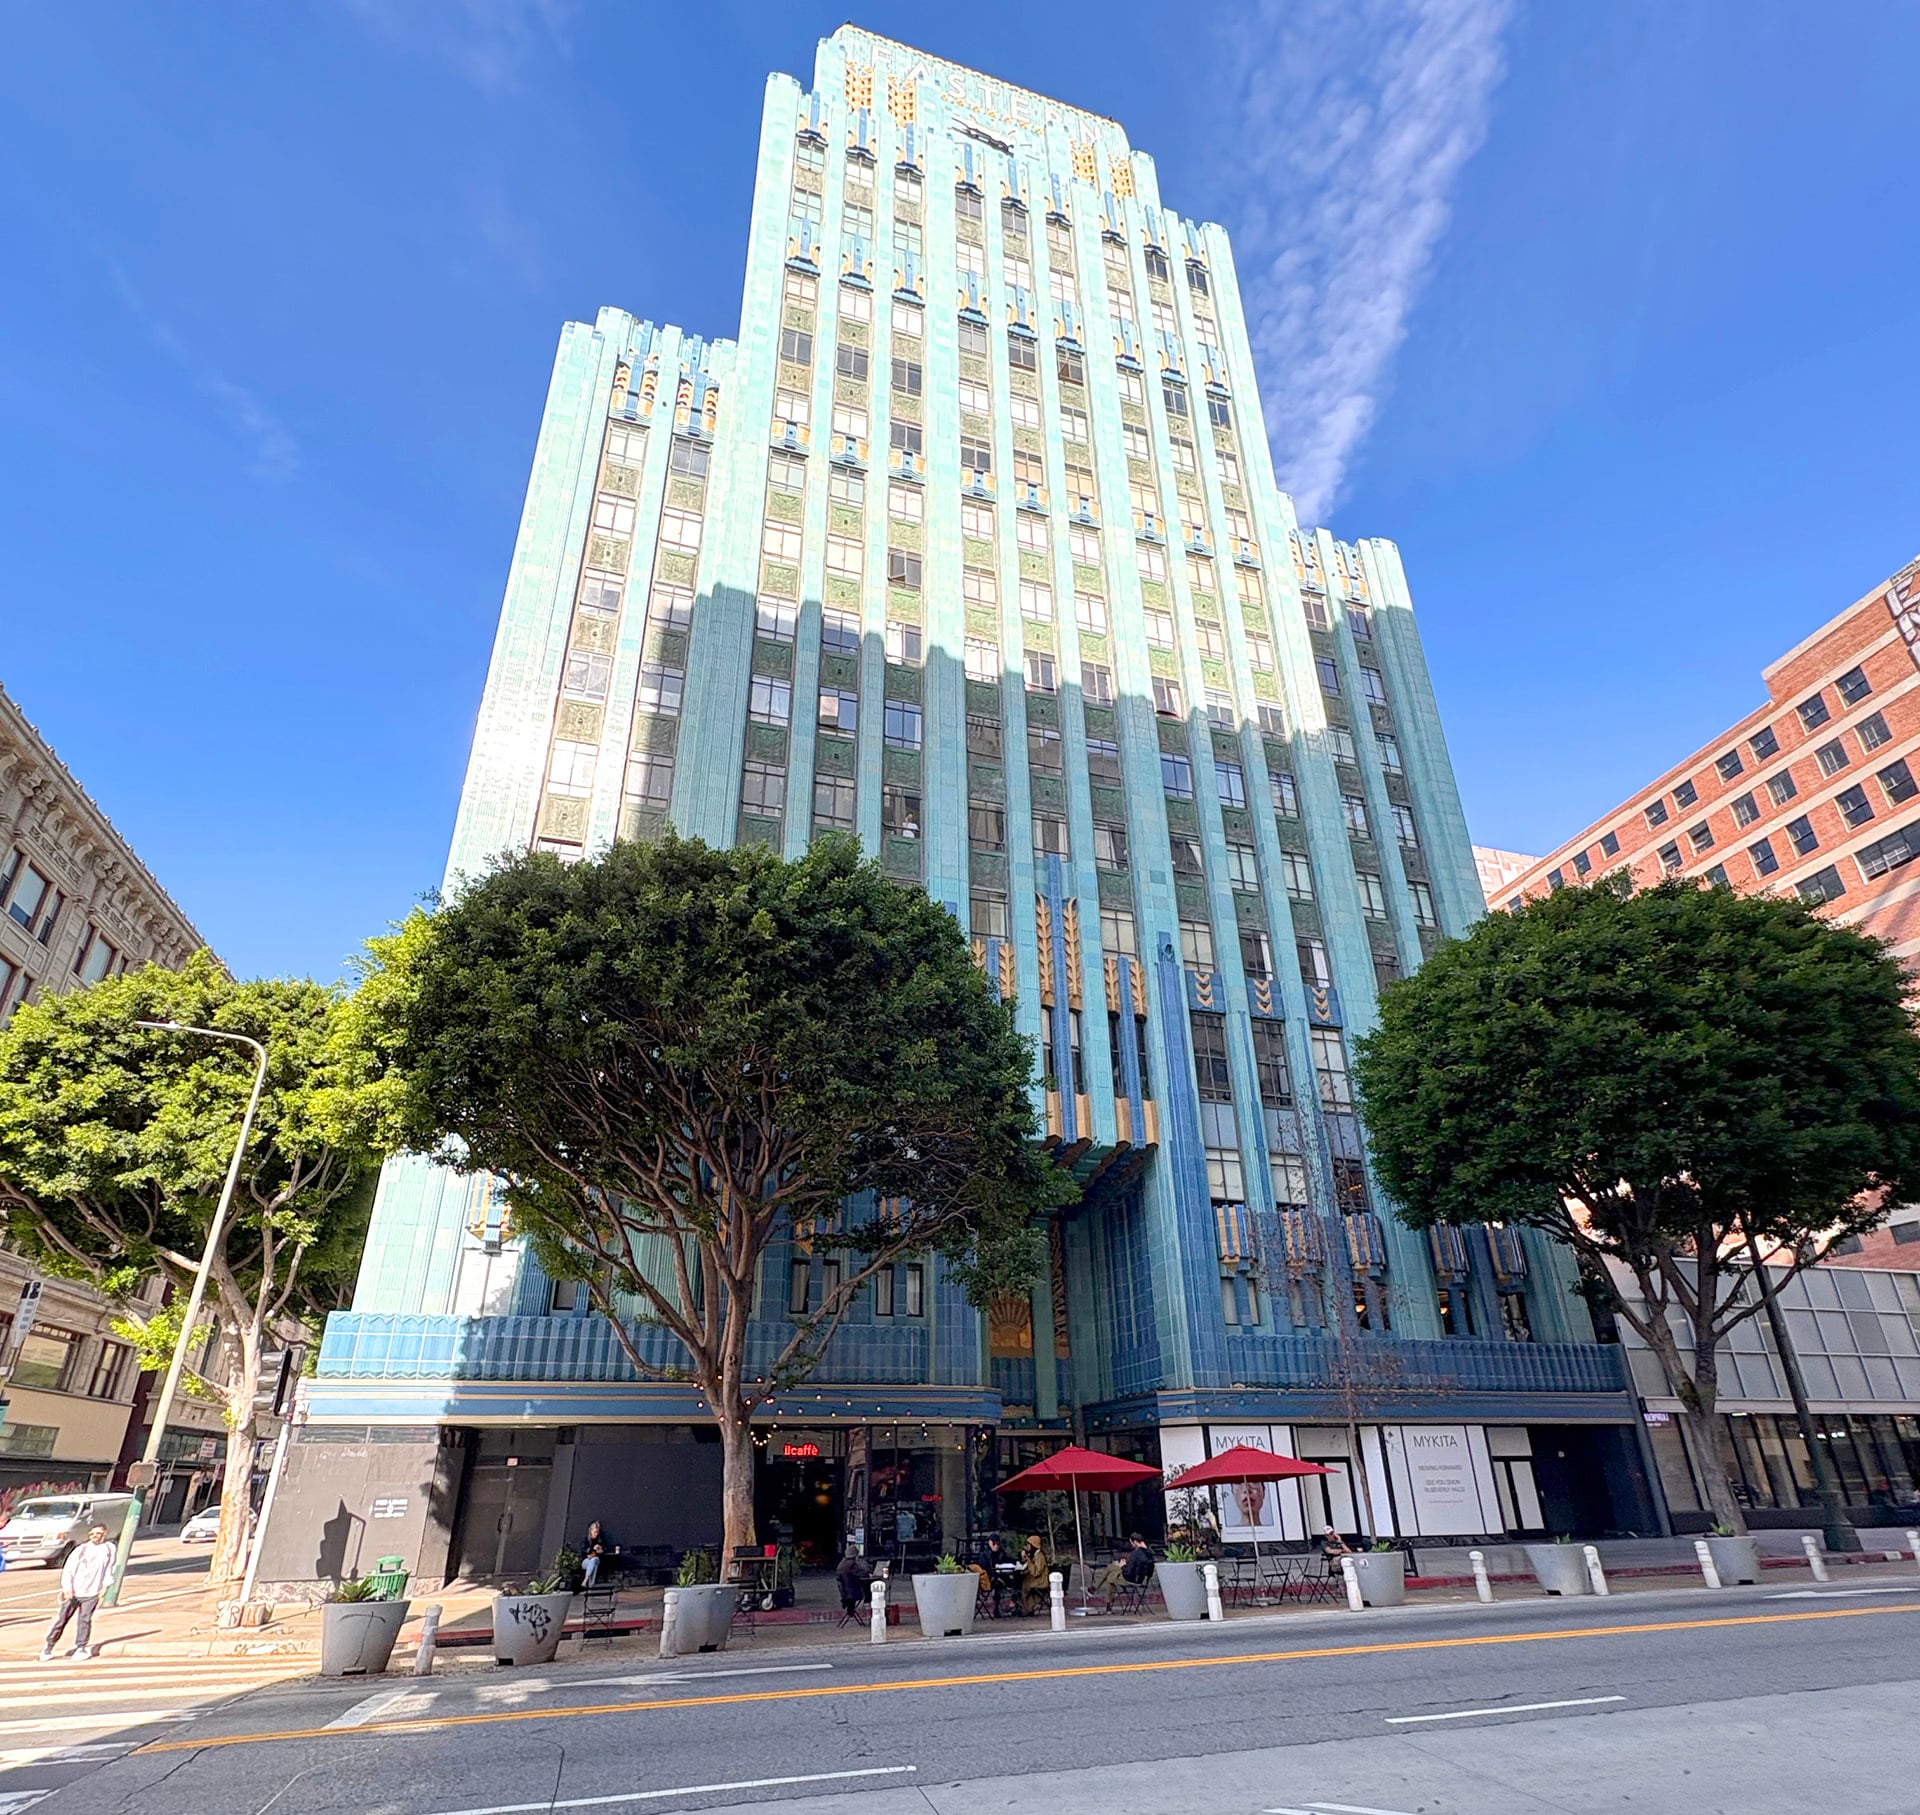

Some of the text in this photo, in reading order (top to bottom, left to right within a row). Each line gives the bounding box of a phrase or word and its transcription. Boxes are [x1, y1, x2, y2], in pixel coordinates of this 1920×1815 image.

[872, 45, 1101, 144] EASTERN
[1215, 1436, 1265, 1448] MYKITA
[1413, 1435, 1458, 1447] MYKITA
